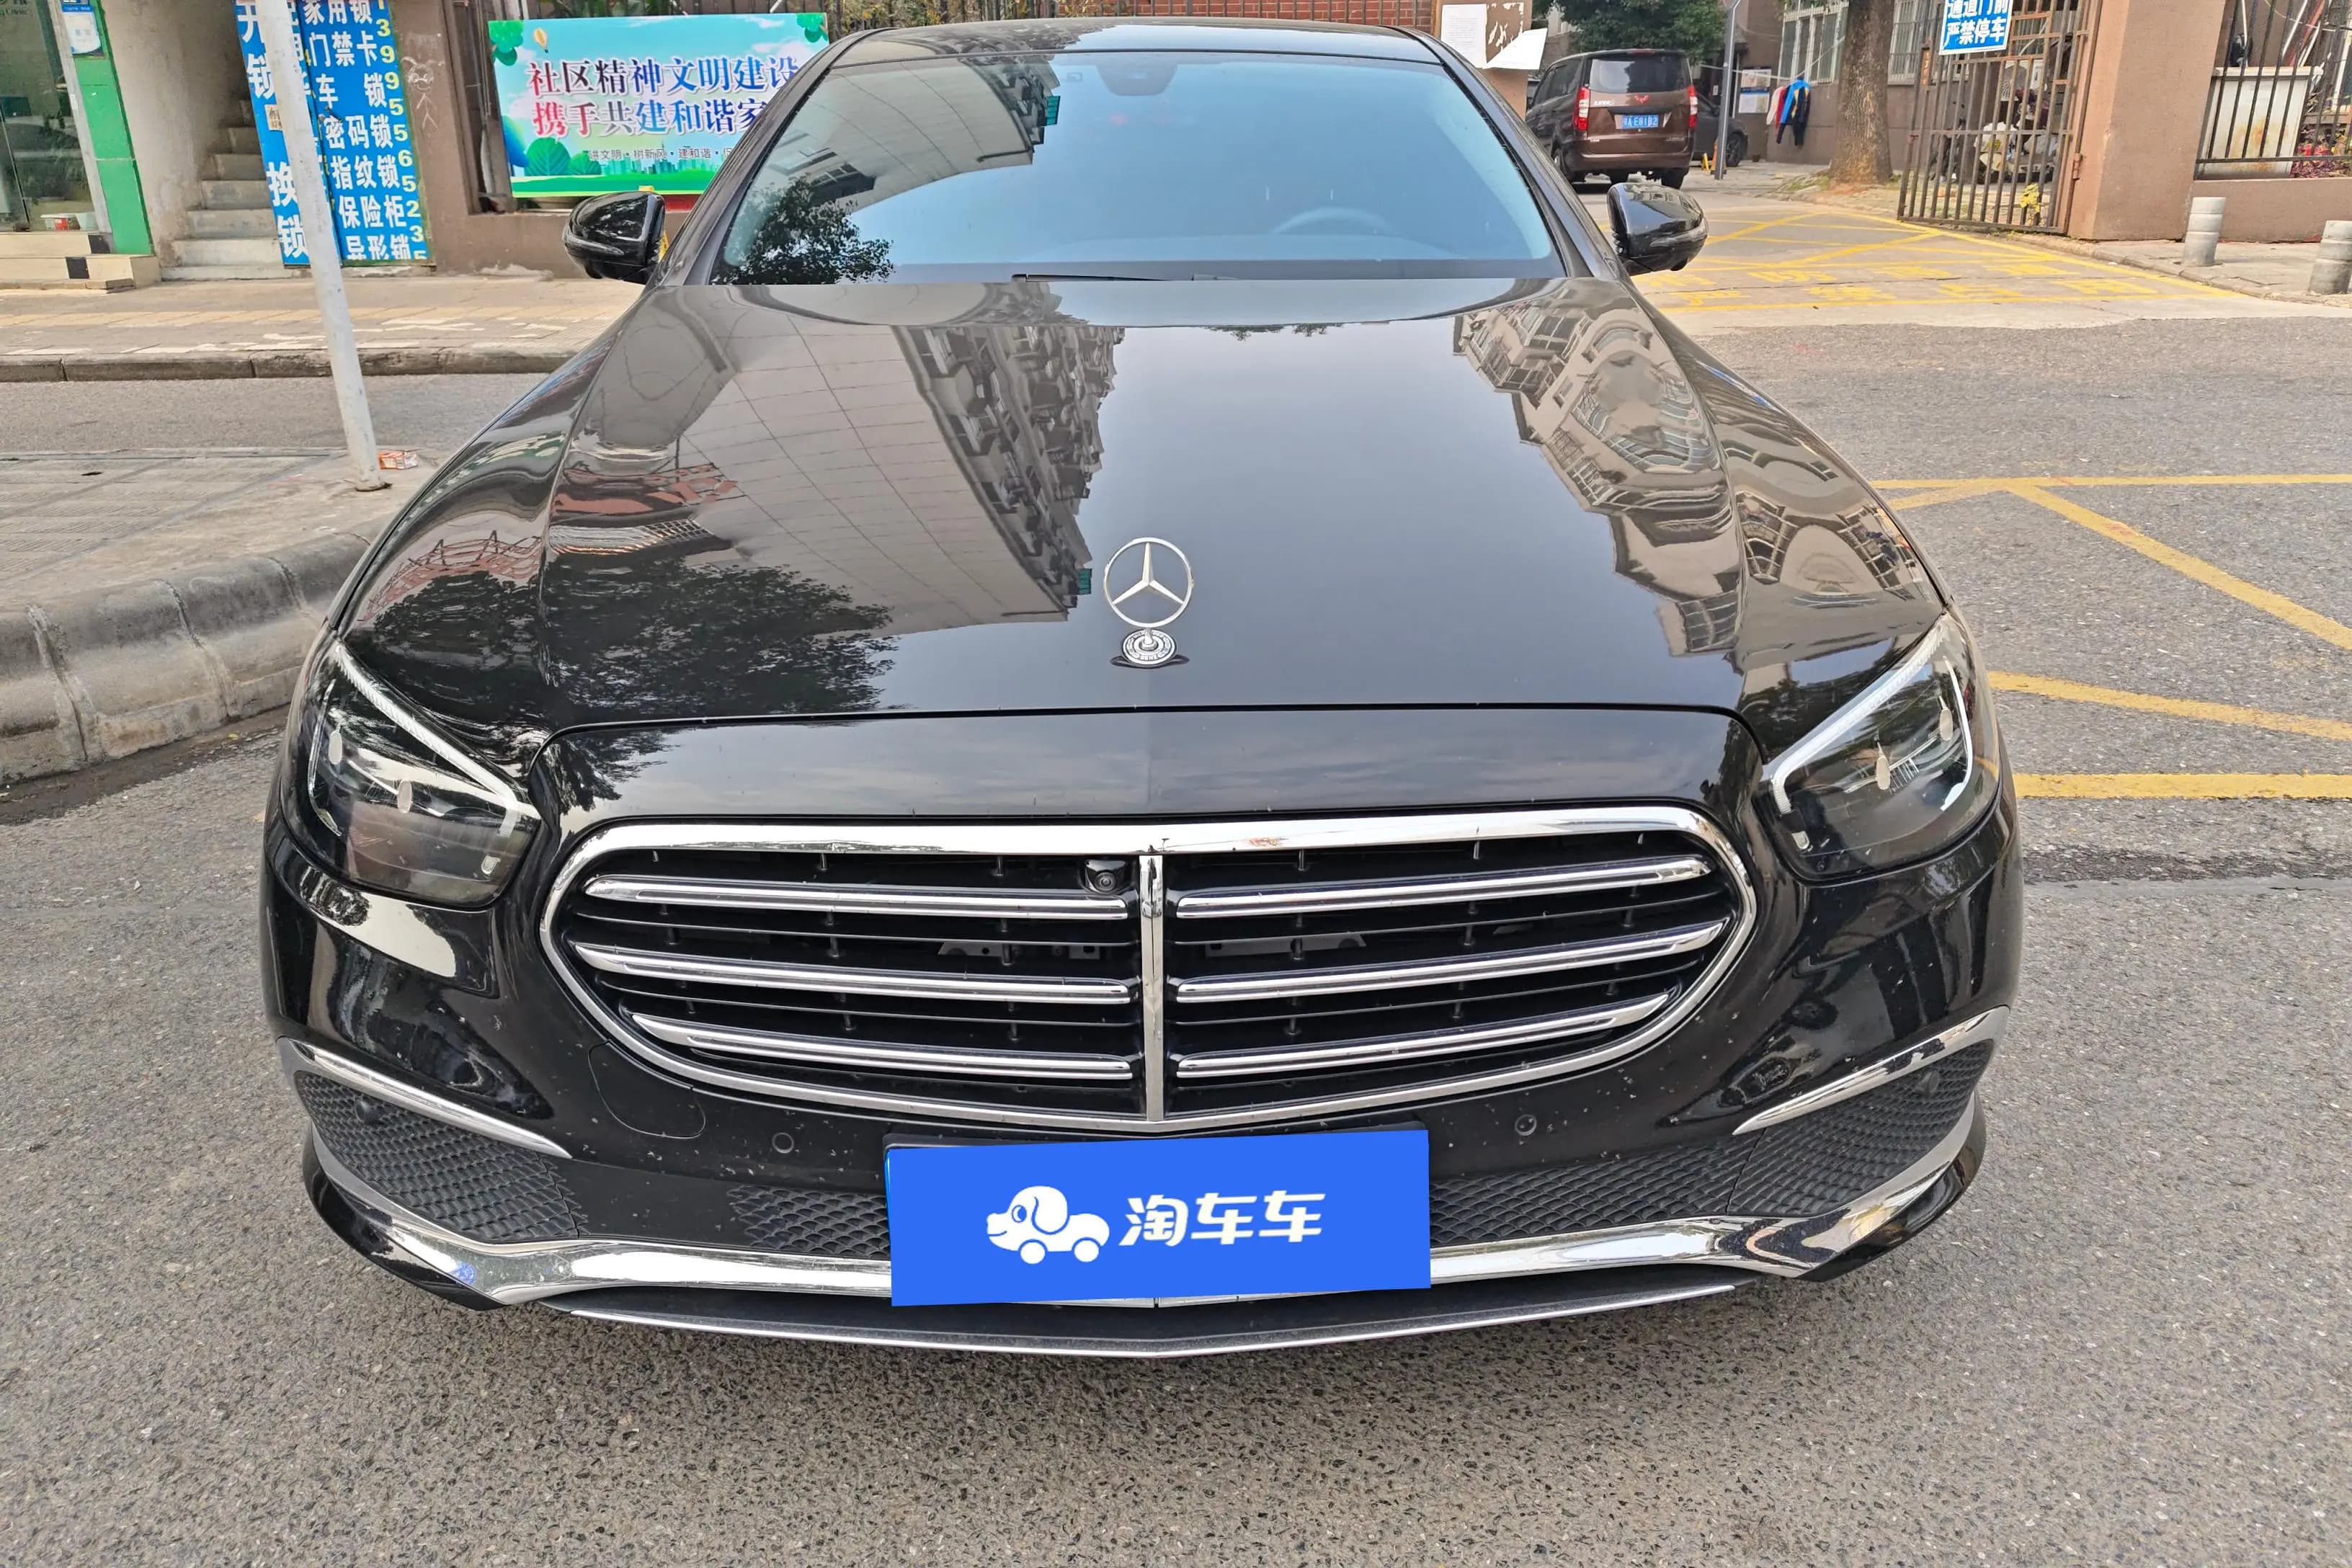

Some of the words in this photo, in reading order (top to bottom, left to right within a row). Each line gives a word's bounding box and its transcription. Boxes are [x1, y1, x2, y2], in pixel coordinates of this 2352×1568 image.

[308, 30, 377, 67] 门禁卡
[1943, 17, 2007, 47] 严禁停车
[530, 56, 798, 95] 社区精神文明建设
[324, 113, 393, 149] 密码锁
[331, 154, 400, 190] 指纹锁
[339, 195, 406, 228] 保险柜
